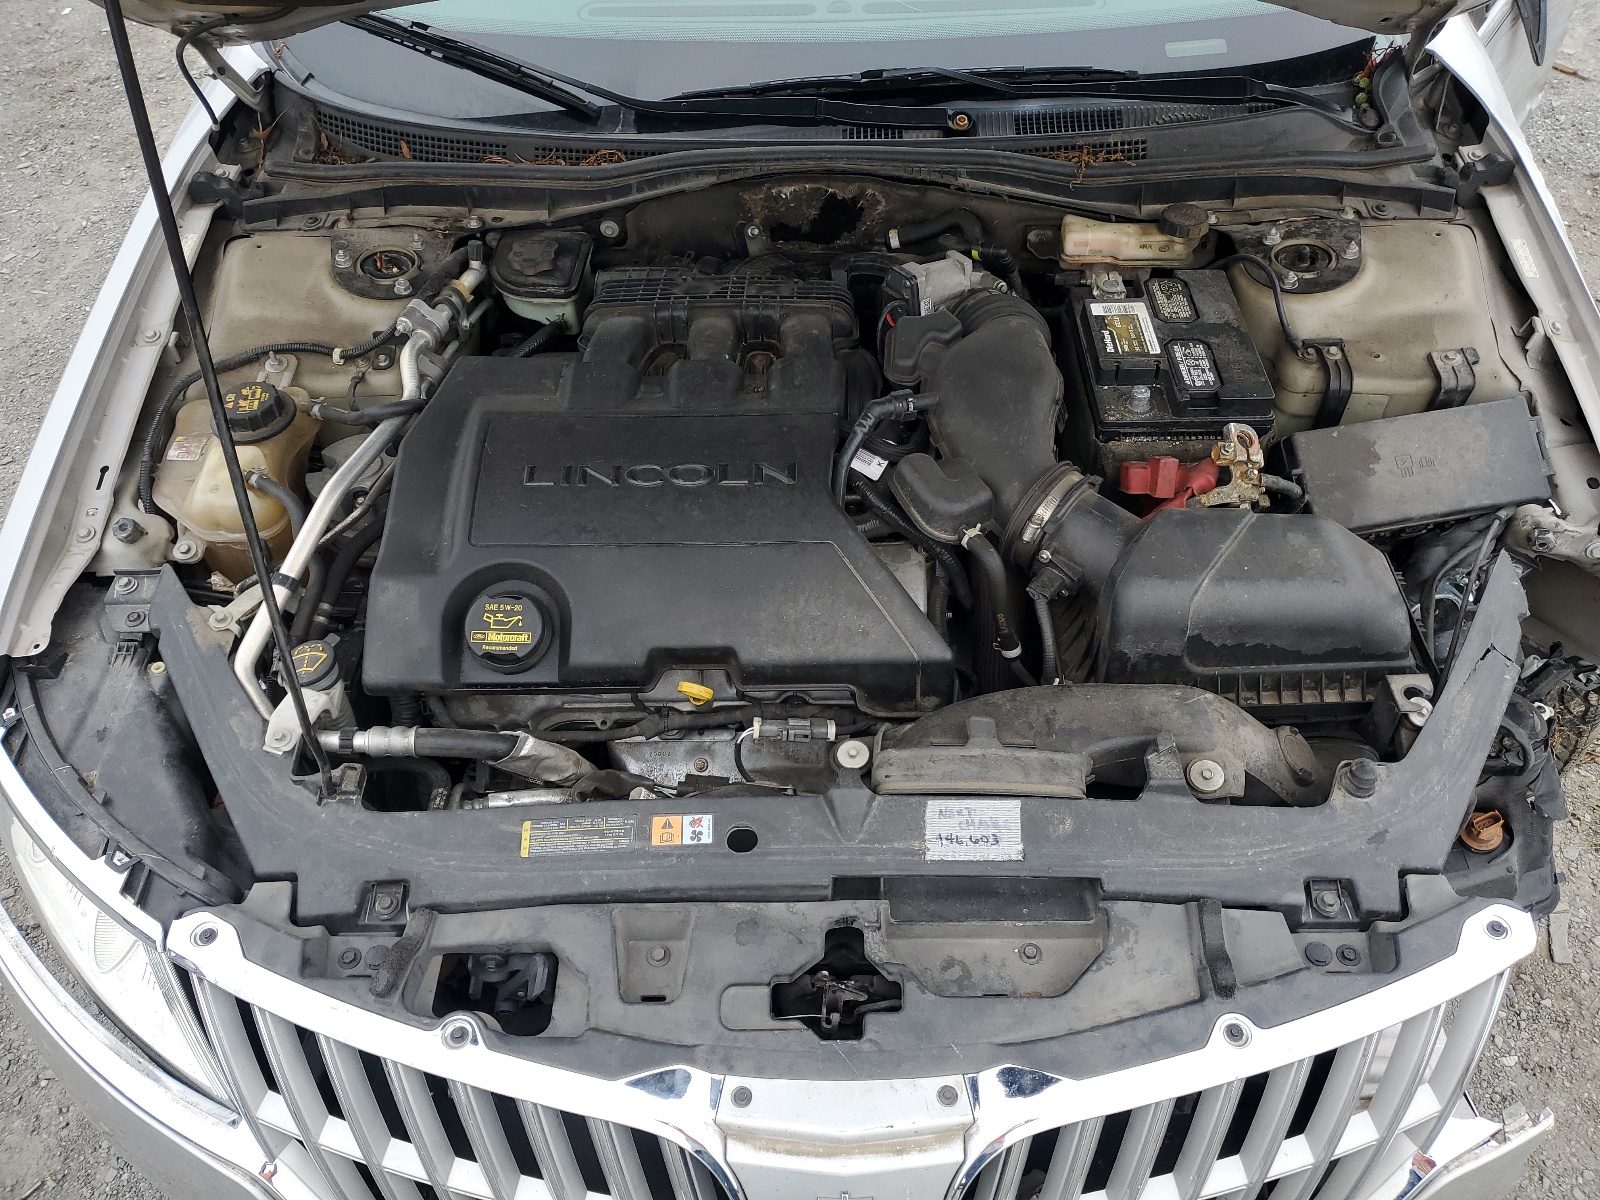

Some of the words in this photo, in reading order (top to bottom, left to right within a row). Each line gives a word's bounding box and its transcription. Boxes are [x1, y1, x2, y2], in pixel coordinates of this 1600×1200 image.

[523, 462, 798, 487] LINCOLN
[484, 603, 499, 611] SAE
[487, 633, 530, 642] Motorcraft
